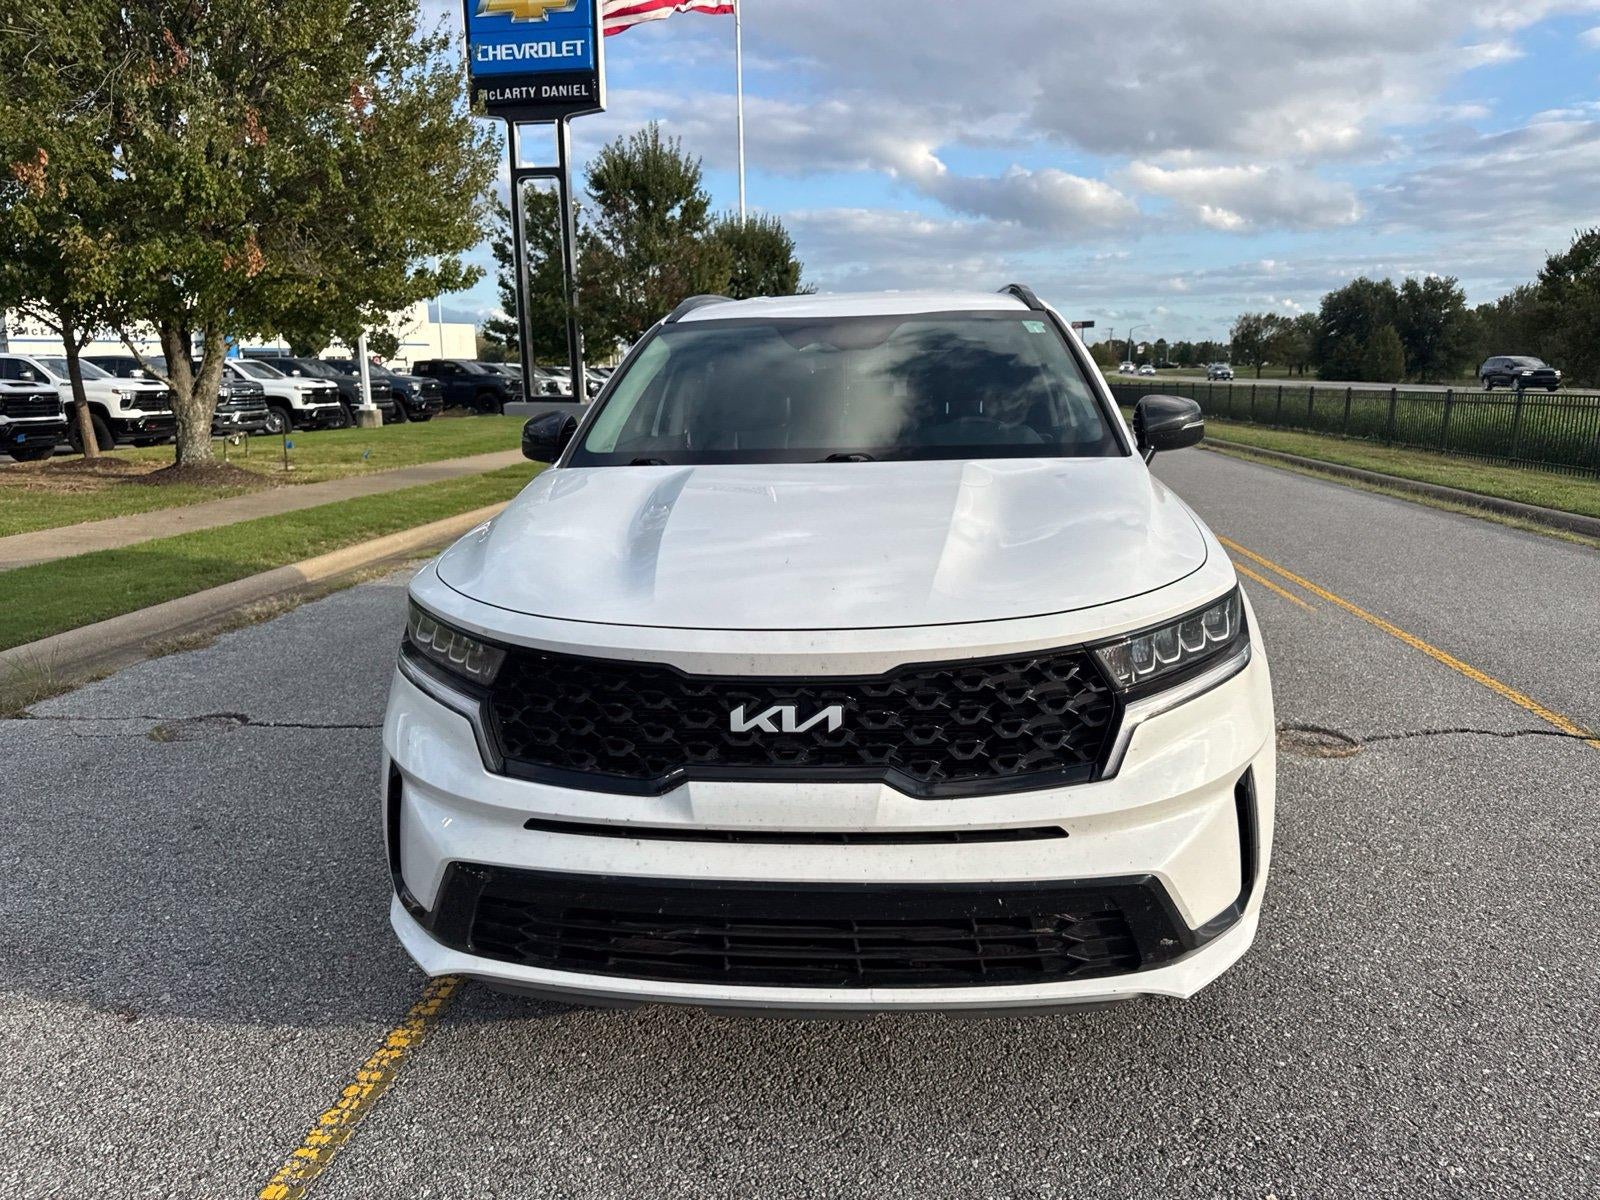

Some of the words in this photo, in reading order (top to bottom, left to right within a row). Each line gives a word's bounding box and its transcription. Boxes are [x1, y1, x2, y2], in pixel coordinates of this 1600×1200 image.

[477, 40, 585, 62] CHEVROLET
[542, 84, 589, 98] DANIEL
[730, 705, 842, 733] KIA
